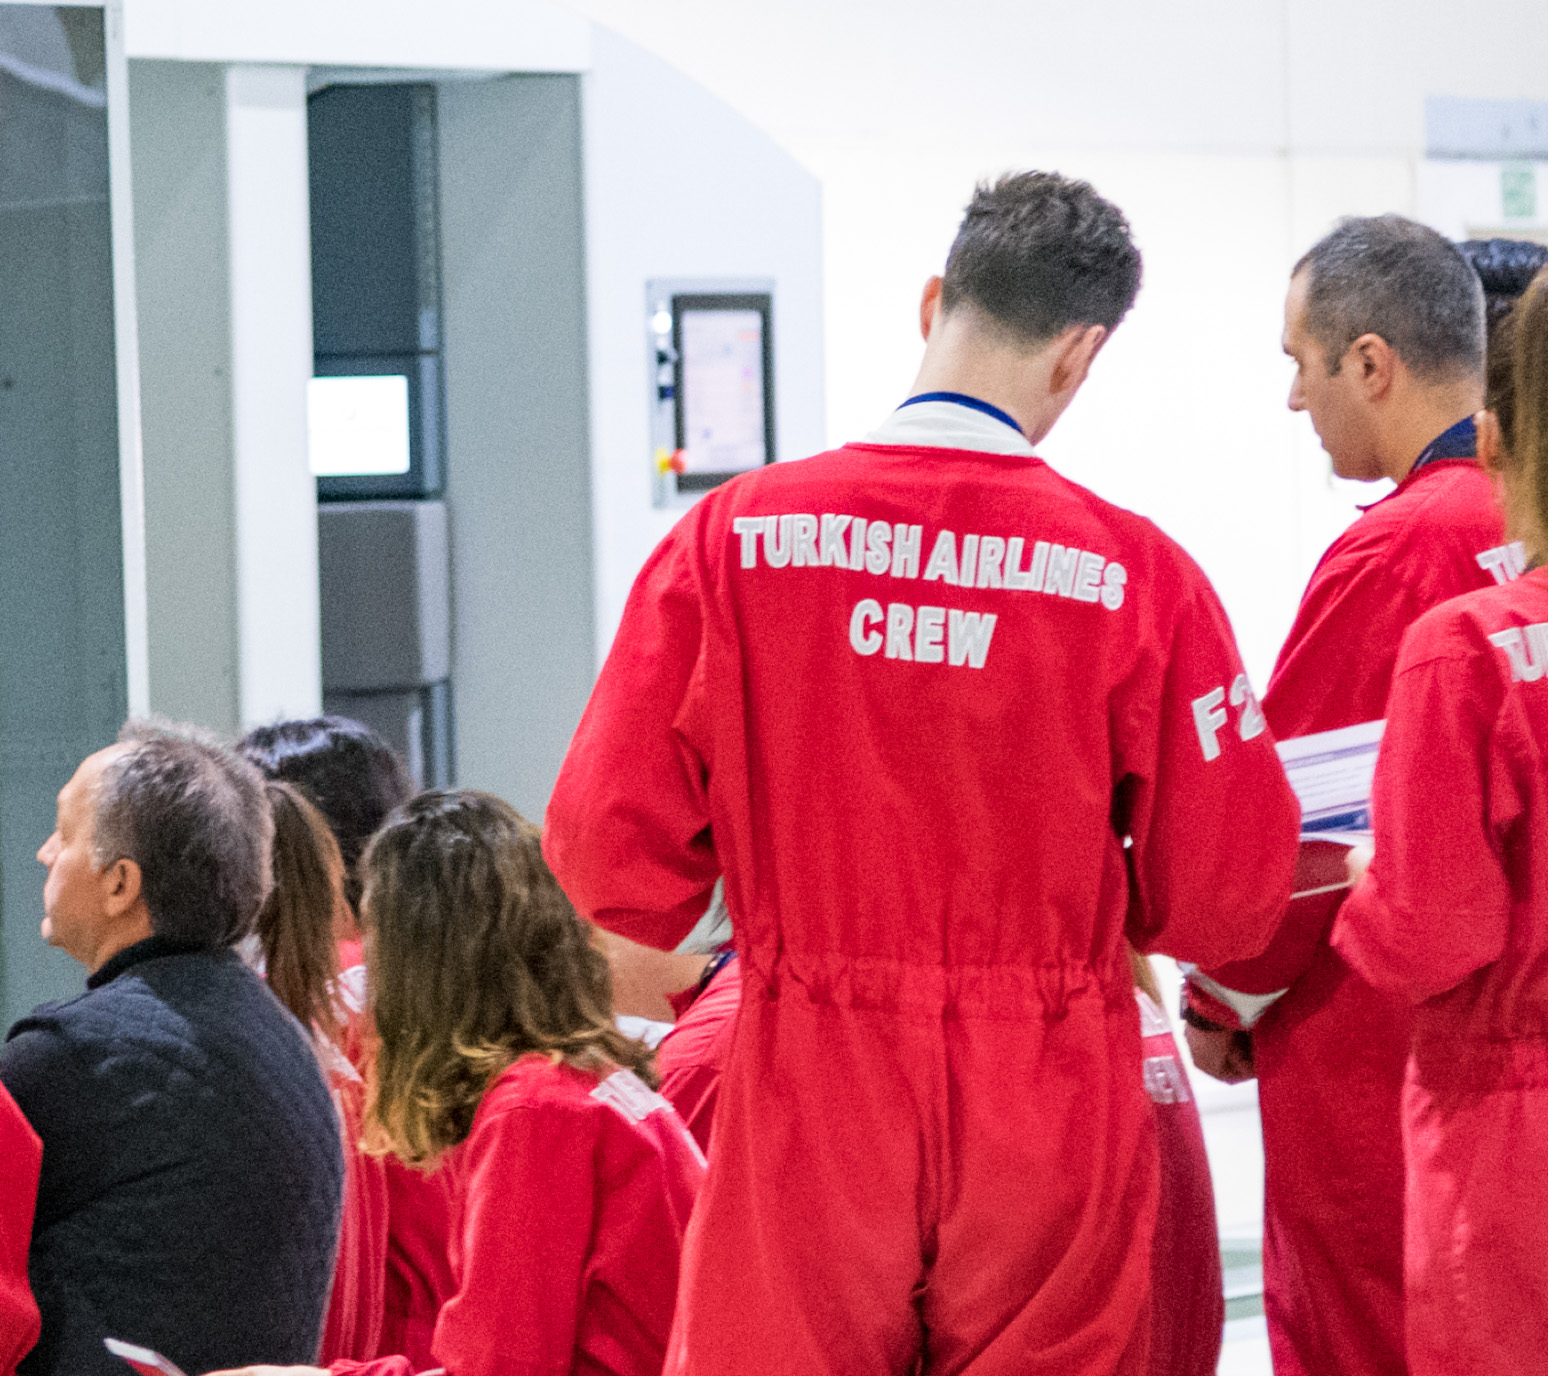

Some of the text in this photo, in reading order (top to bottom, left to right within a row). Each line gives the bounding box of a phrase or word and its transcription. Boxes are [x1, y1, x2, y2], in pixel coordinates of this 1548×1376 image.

[732, 512, 1128, 611] TURKISH AIRLINES
[848, 598, 998, 669] CREW
